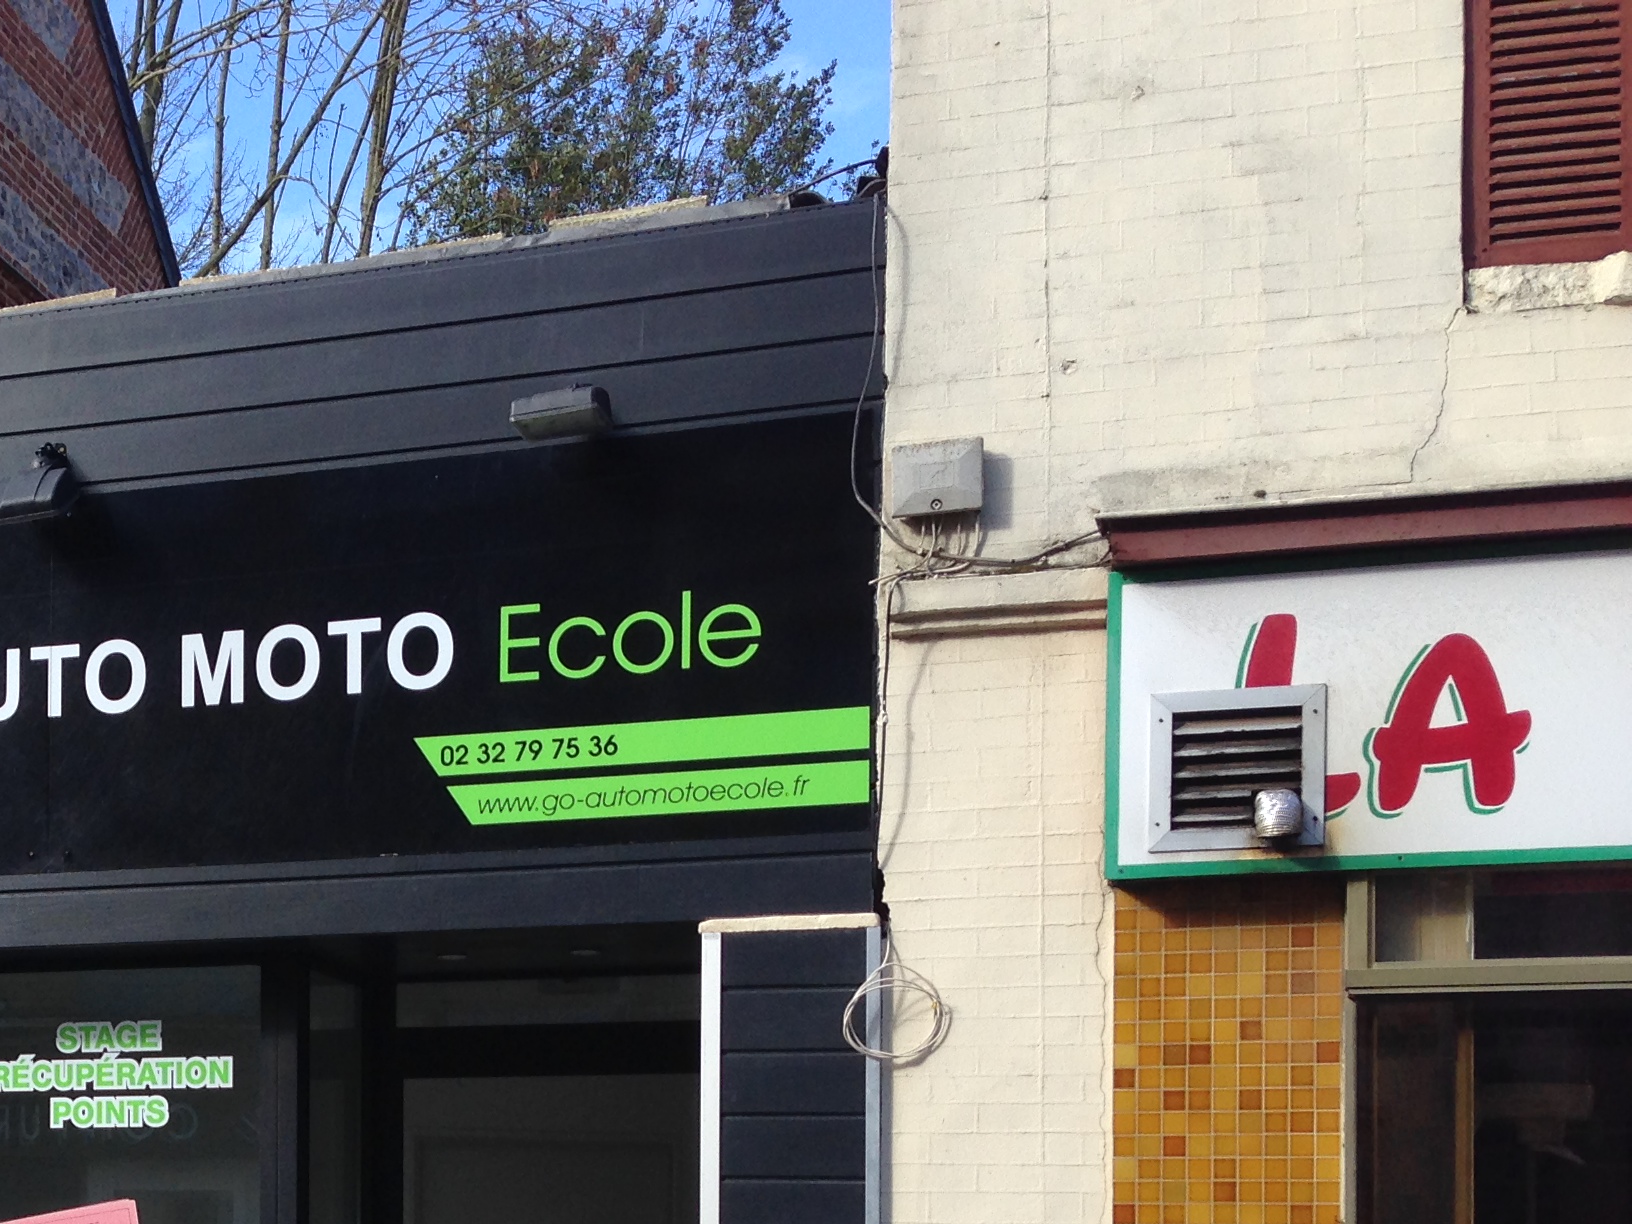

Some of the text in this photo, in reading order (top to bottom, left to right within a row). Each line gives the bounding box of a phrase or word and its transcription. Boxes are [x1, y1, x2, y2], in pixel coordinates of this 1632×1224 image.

[180, 611, 455, 708] MOTO
[498, 590, 762, 683] Ecole
[440, 734, 619, 767] 02 32 79 75 36
[477, 774, 811, 817] www.go-automotoecole.fr
[56, 1020, 163, 1054] STAGE
[49, 1095, 170, 1129] POINTS
